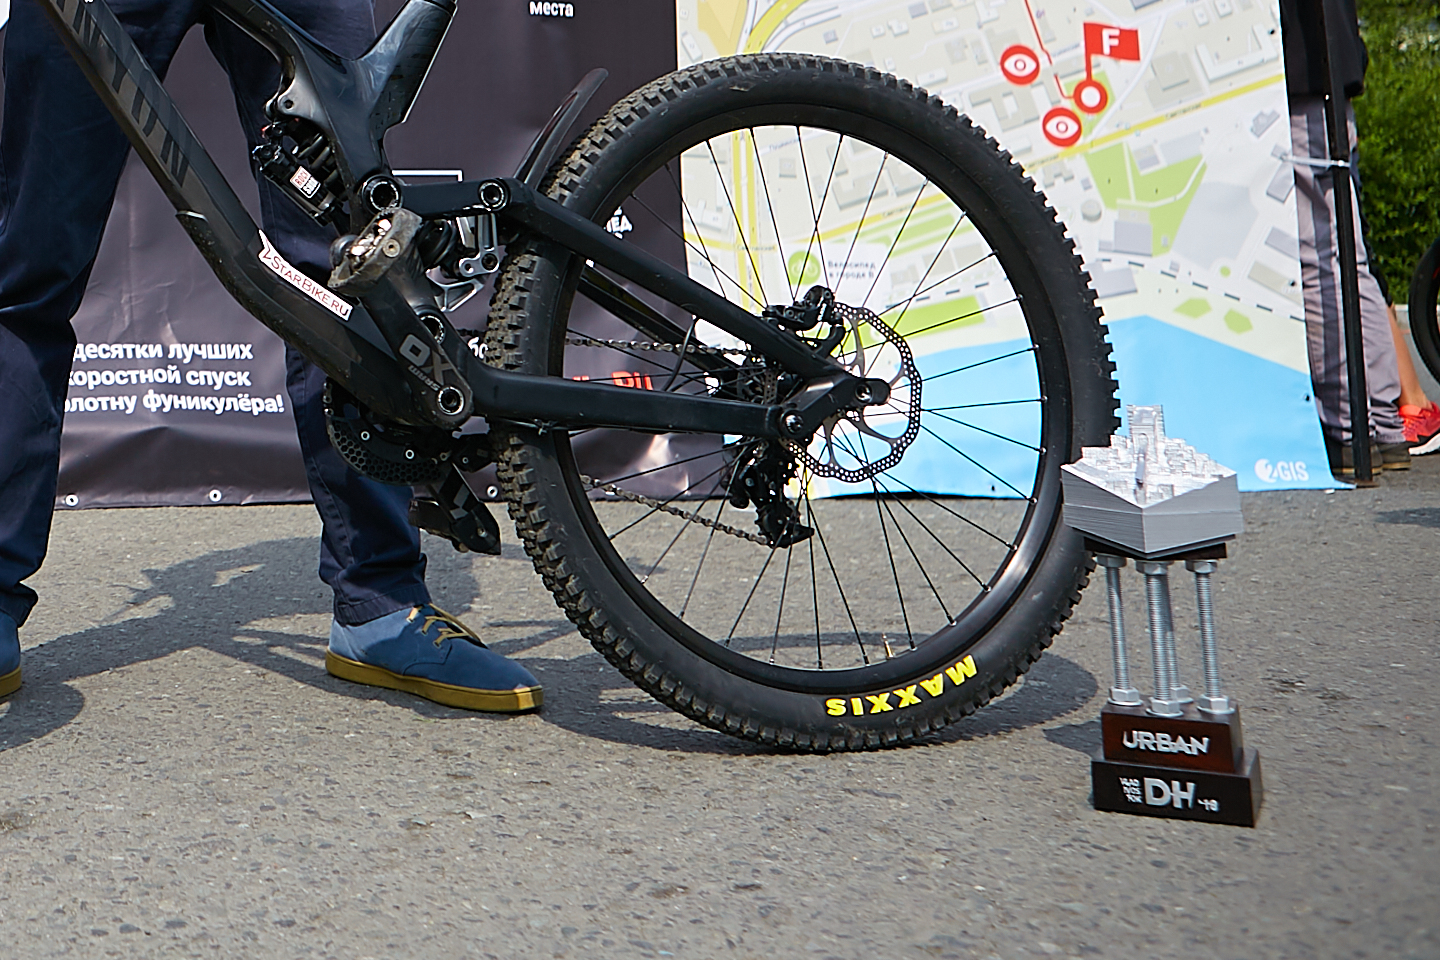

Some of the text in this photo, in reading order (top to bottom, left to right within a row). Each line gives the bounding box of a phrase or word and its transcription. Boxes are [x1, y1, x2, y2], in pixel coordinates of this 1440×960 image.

[529, 0, 575, 17] места
[72, 342, 254, 364] десятки лучших
[185, 369, 252, 391] спуск
[142, 389, 285, 416] фуникулёра!
[1254, 458, 1310, 484] 2GIS
[825, 654, 978, 717] MAXXIS
[1122, 730, 1210, 756] URBAN
[1143, 776, 1197, 810] DH
